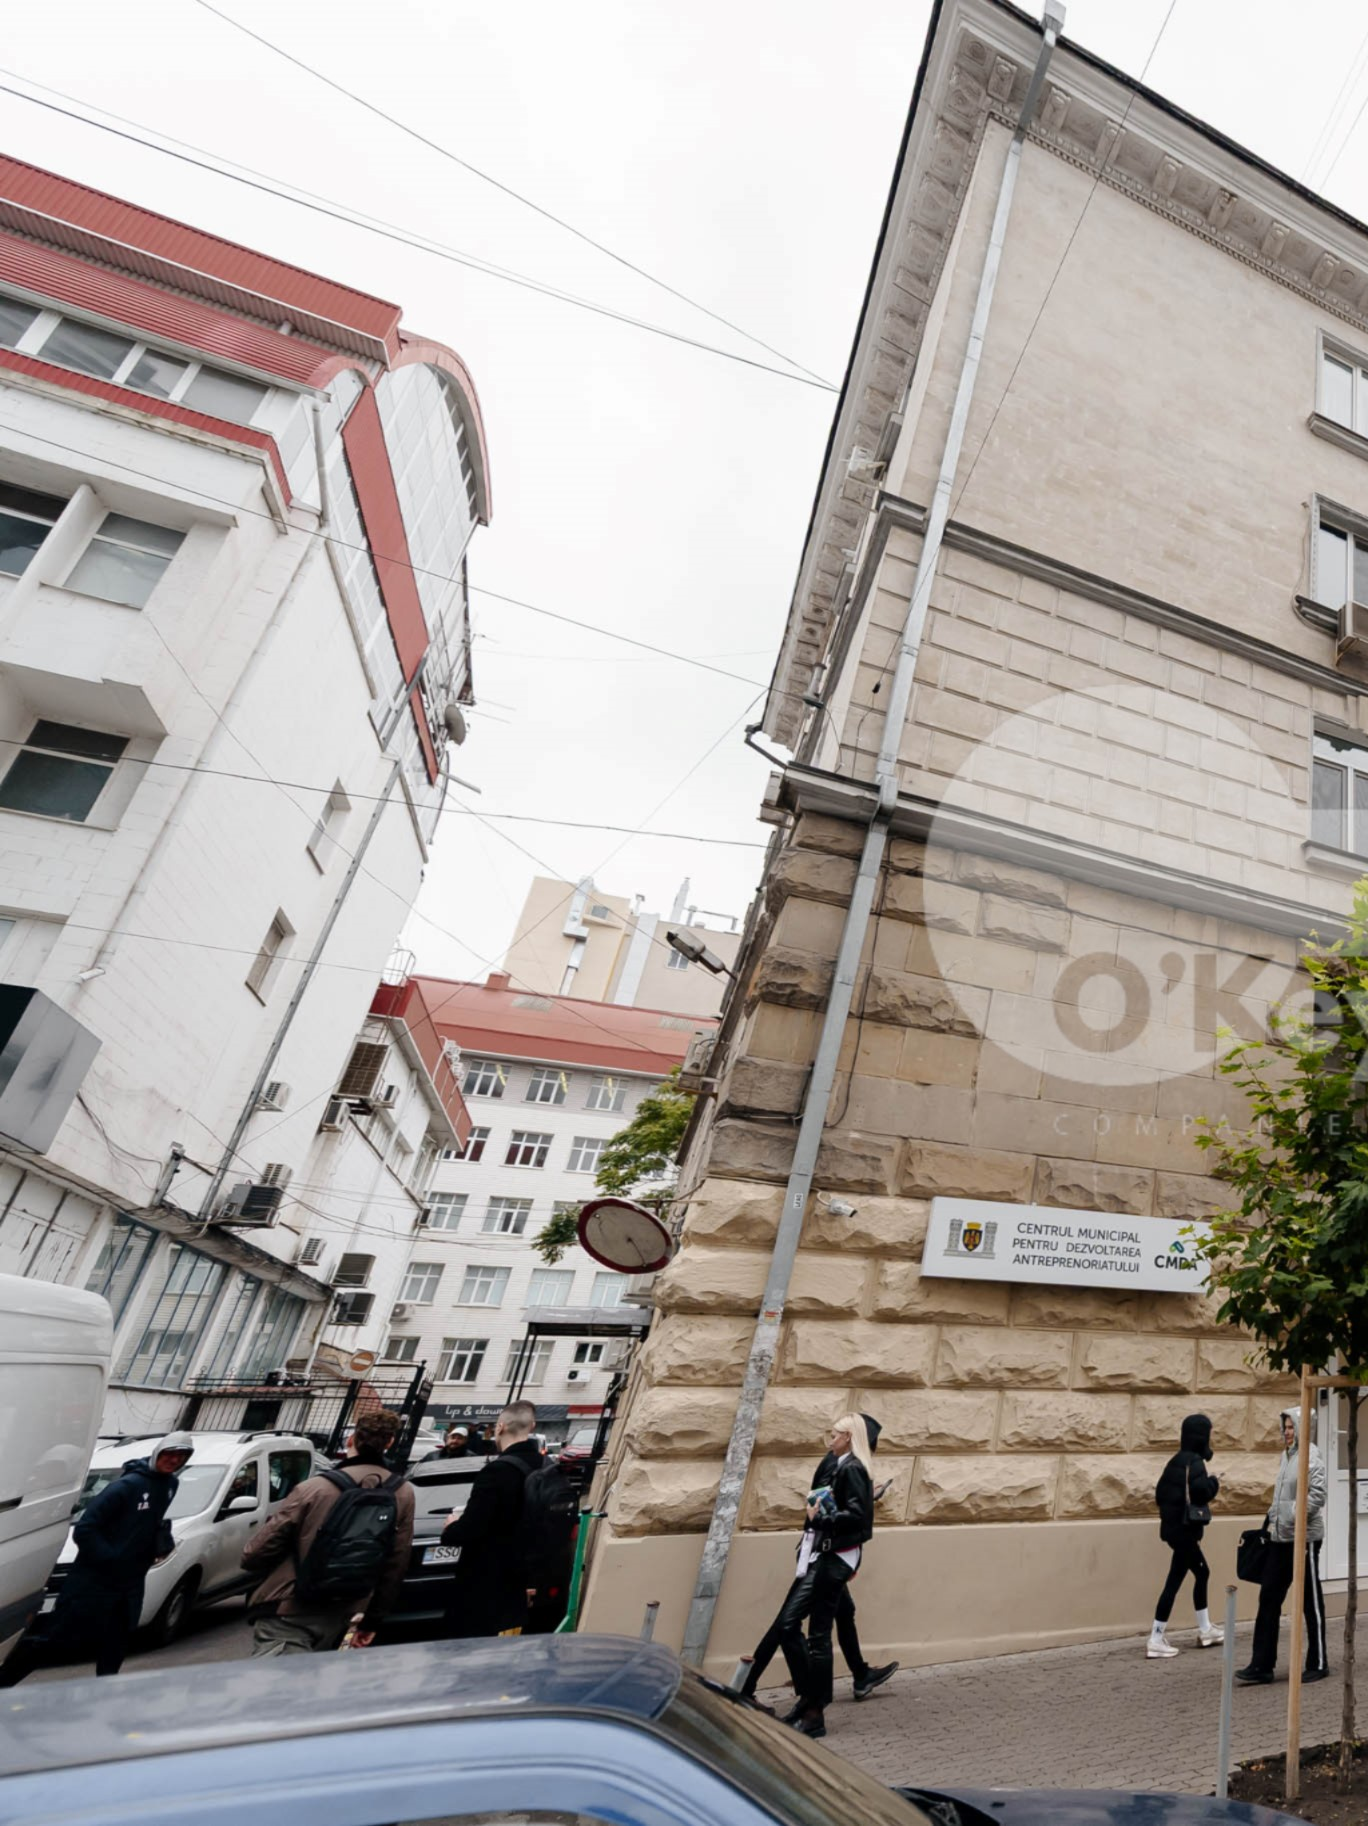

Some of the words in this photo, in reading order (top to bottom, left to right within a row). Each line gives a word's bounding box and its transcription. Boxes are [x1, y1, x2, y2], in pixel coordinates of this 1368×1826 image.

[1017, 1222, 1074, 1237] CENTRUL
[1077, 1227, 1141, 1244] MUNICIPAL
[1012, 1237, 1059, 1251] PENTRU
[1065, 1242, 1142, 1258] DEZVOLTAREA
[1012, 1253, 1140, 1273] ANTREPRENORIATULUI
[463, 1405, 473, 1416] &
